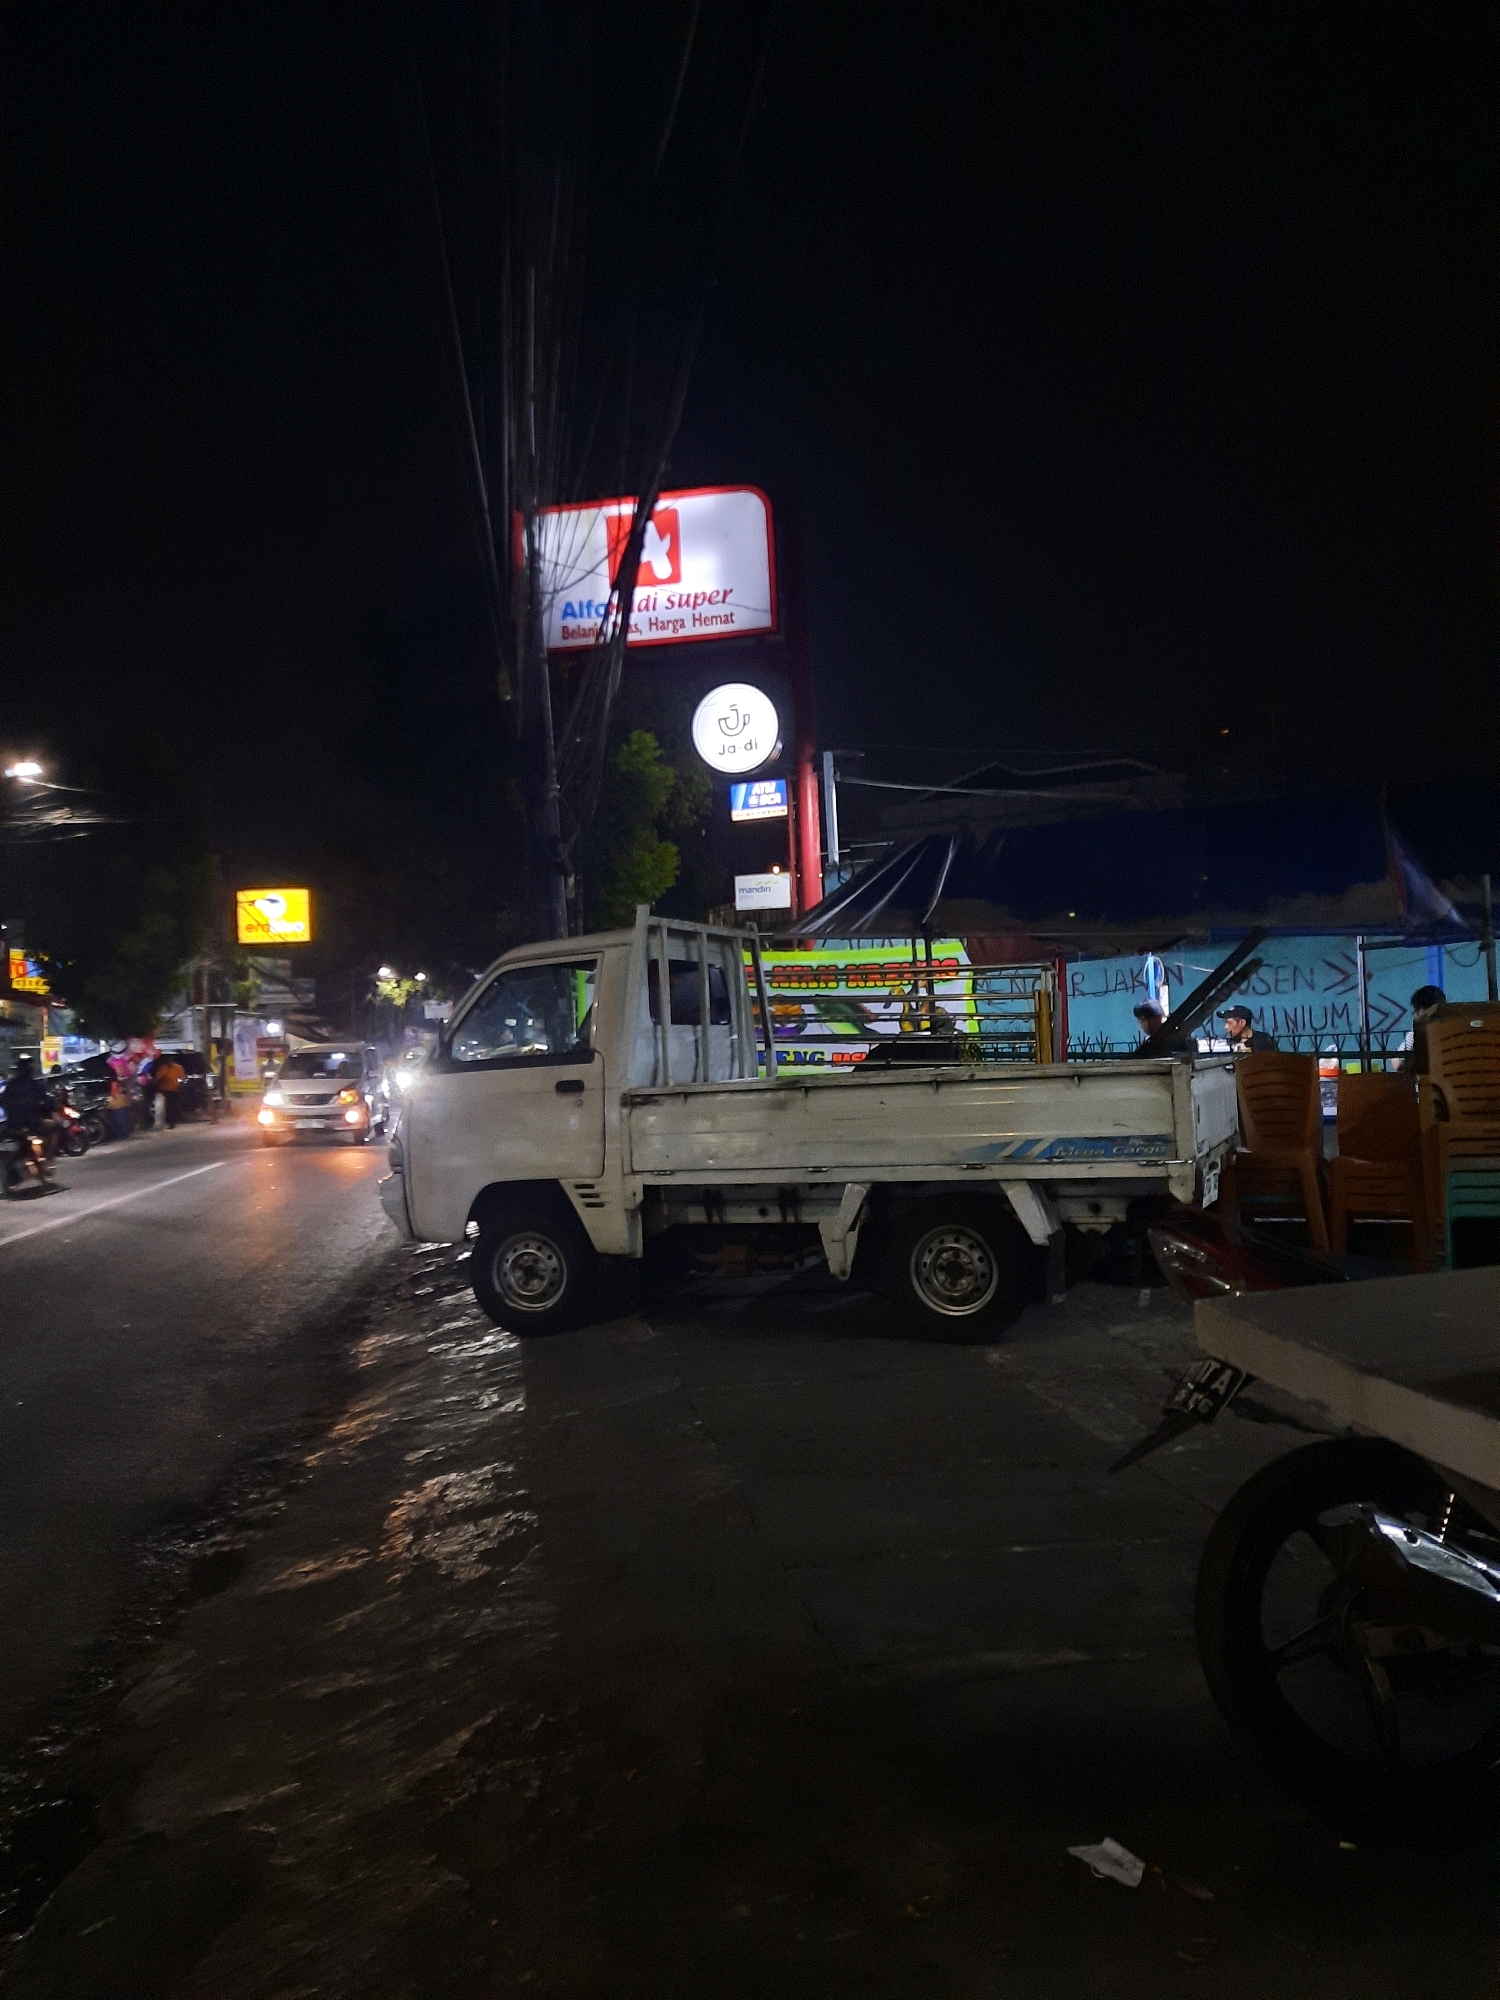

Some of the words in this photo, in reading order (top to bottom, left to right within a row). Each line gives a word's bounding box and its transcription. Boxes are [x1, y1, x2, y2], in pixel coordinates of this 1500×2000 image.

[562, 592, 658, 620] Alfadi
[665, 588, 734, 611] super
[649, 616, 686, 634] Harga
[693, 611, 735, 627] Hemat
[751, 782, 776, 796] ATM
[738, 885, 772, 894] mandiri
[1055, 1146, 1105, 1158] Mega
[1112, 1144, 1167, 1157] Cargo
